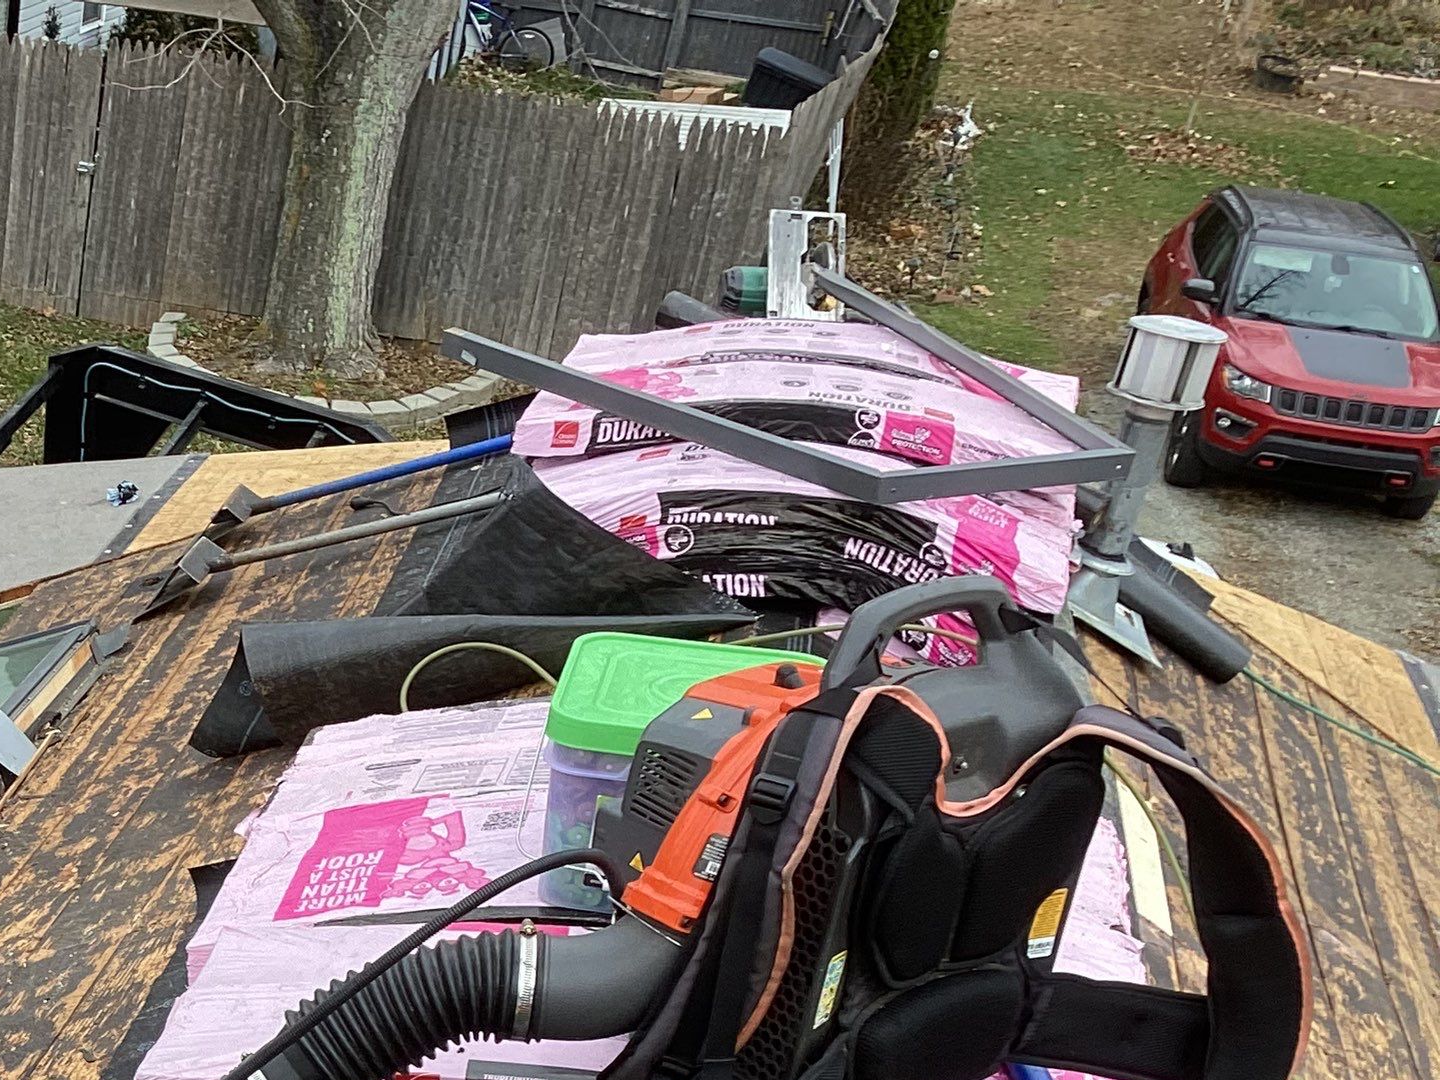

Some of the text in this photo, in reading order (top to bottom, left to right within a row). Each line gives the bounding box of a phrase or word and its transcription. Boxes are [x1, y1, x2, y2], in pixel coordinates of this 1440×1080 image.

[843, 537, 938, 583] URATION
[315, 849, 384, 870] ROOF
[310, 865, 376, 884] JUST A
[301, 877, 368, 899] THAN
[294, 892, 367, 912] MORE
